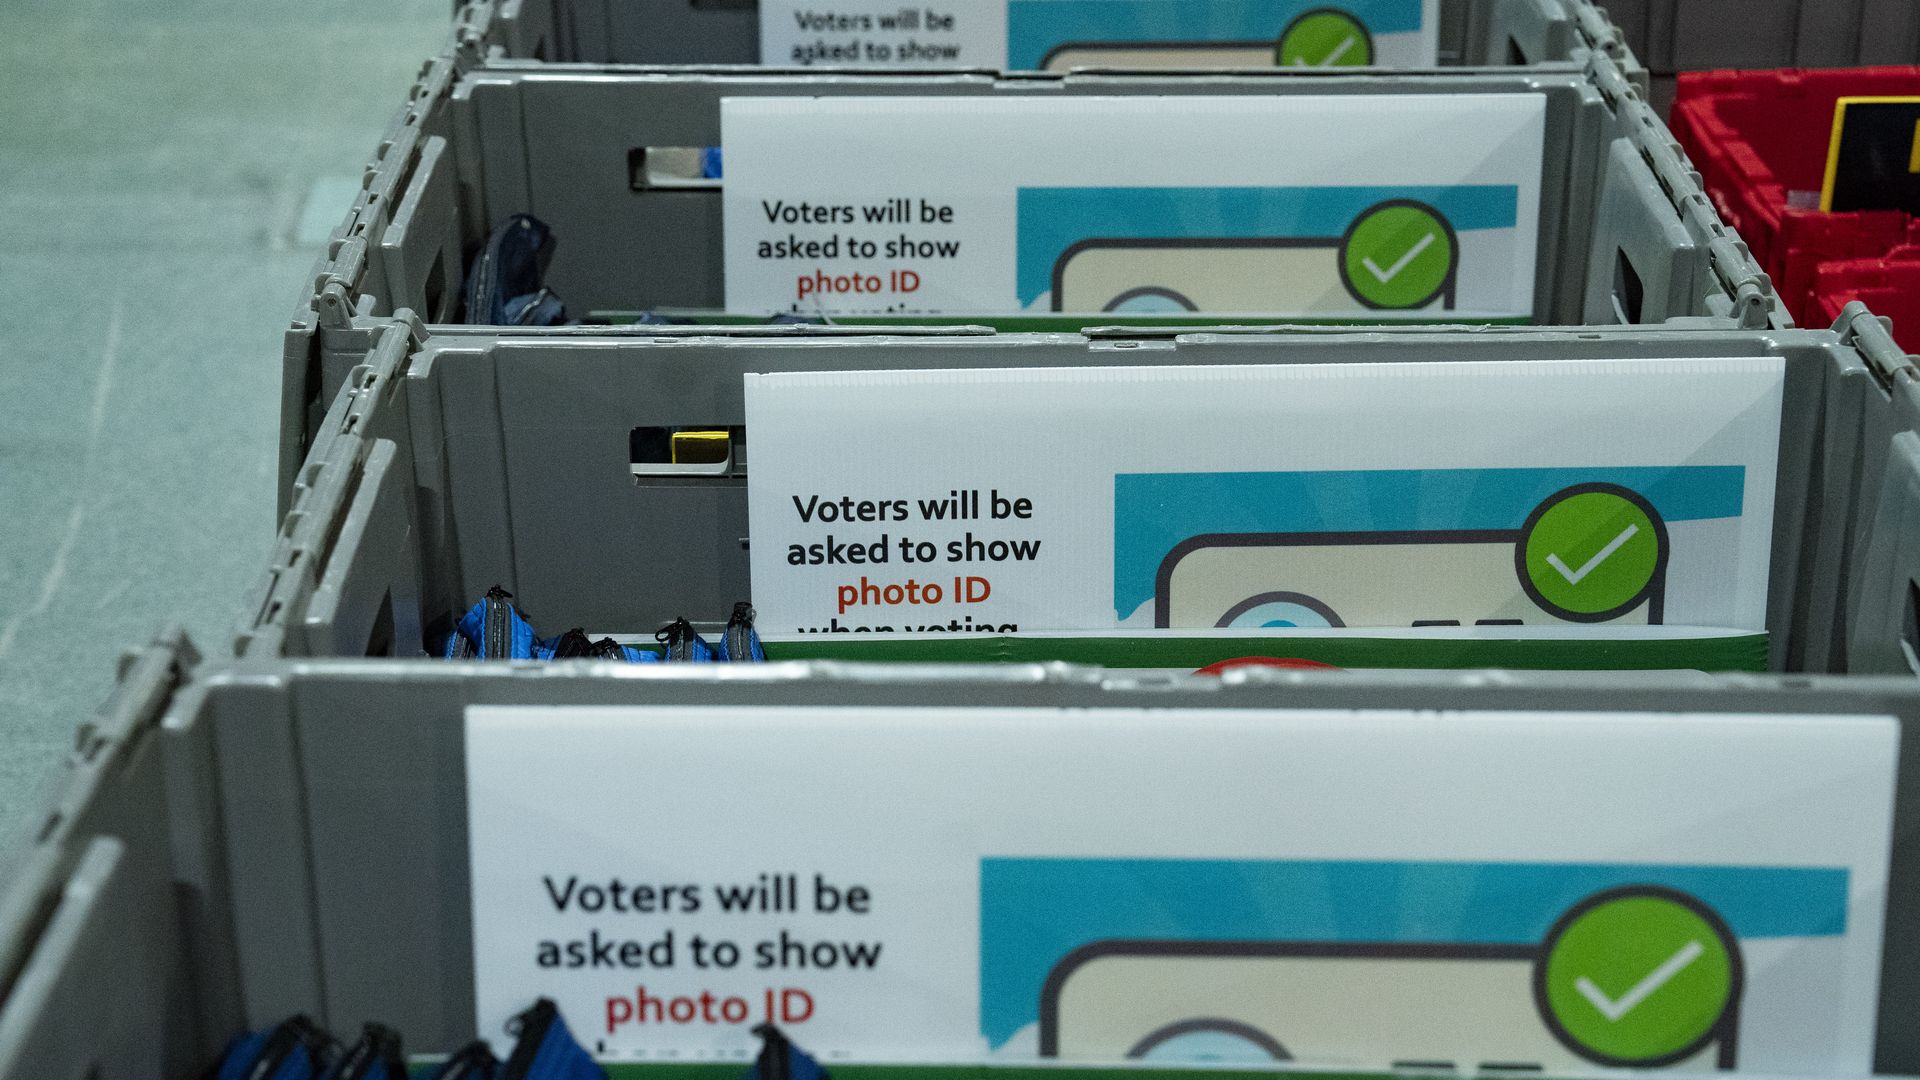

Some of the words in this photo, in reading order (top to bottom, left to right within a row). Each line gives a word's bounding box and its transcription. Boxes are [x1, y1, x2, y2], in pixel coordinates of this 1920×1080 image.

[794, 11, 873, 32] Voters
[925, 11, 954, 31] be
[791, 40, 859, 64] asked
[865, 43, 892, 61] to
[897, 40, 960, 62] show
[762, 200, 854, 224] Voters
[862, 199, 910, 223] will
[920, 199, 953, 223] be
[758, 234, 838, 259] asked
[846, 237, 877, 259] to
[885, 234, 960, 258] show
[798, 269, 881, 301] photo
[891, 271, 920, 292] ID
[792, 495, 908, 522] Voters
[918, 490, 978, 520] will
[991, 490, 1032, 519] be
[788, 534, 888, 565] asked
[899, 538, 936, 563] to
[947, 532, 1041, 562] show
[838, 577, 942, 614] photo
[955, 576, 990, 603] ID
[543, 876, 701, 913] Voters
[714, 874, 797, 913] will
[814, 874, 871, 914] be
[536, 930, 675, 969] asked
[689, 935, 740, 969] to
[755, 930, 882, 970] show
[606, 986, 748, 1034] photo
[766, 988, 814, 1024] ID
